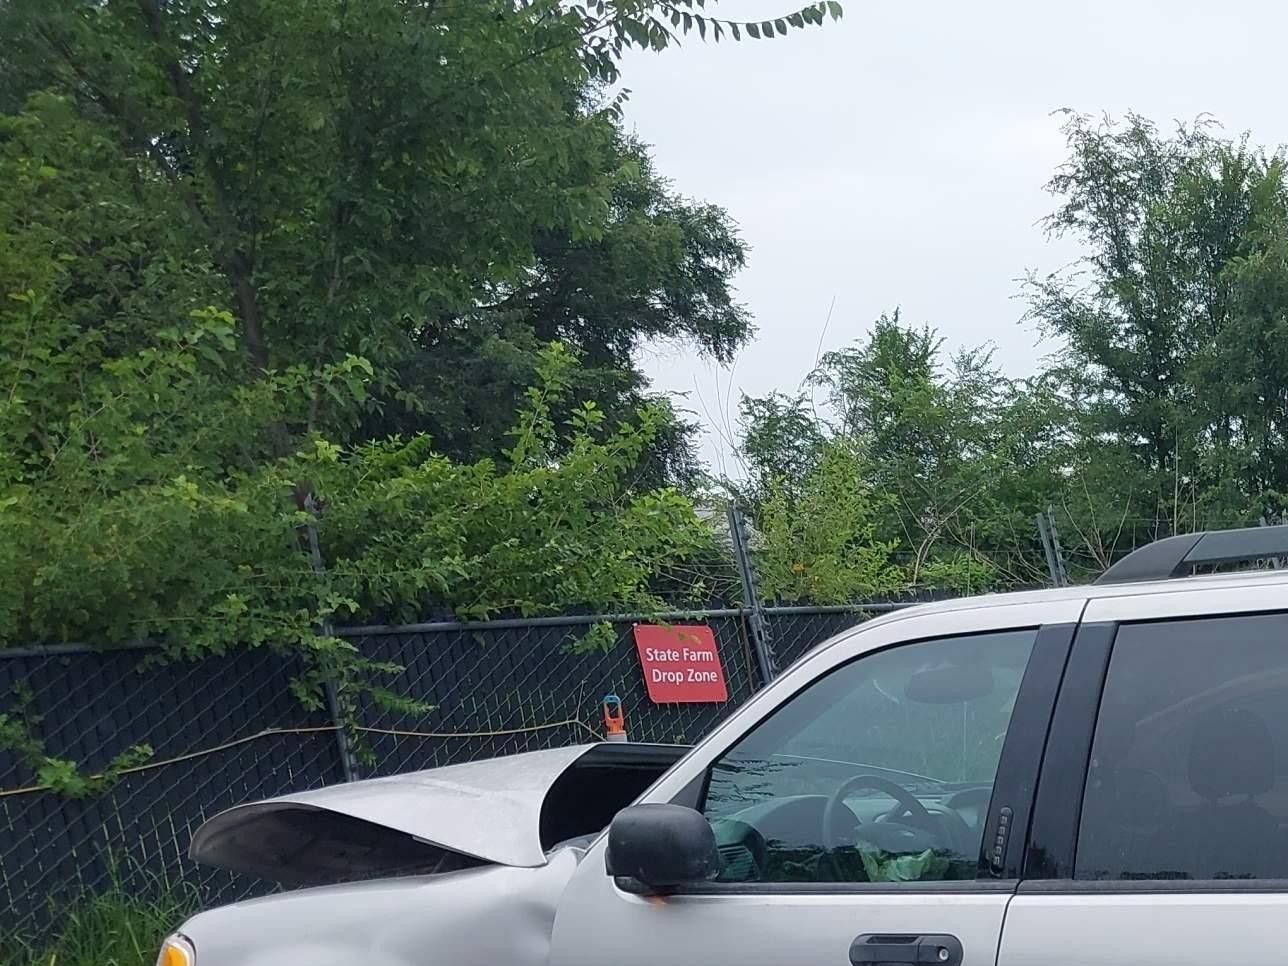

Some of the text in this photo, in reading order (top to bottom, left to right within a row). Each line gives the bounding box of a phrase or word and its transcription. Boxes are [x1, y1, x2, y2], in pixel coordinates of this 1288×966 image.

[646, 647, 713, 662] State Farm
[652, 668, 718, 686] Drop Zone
